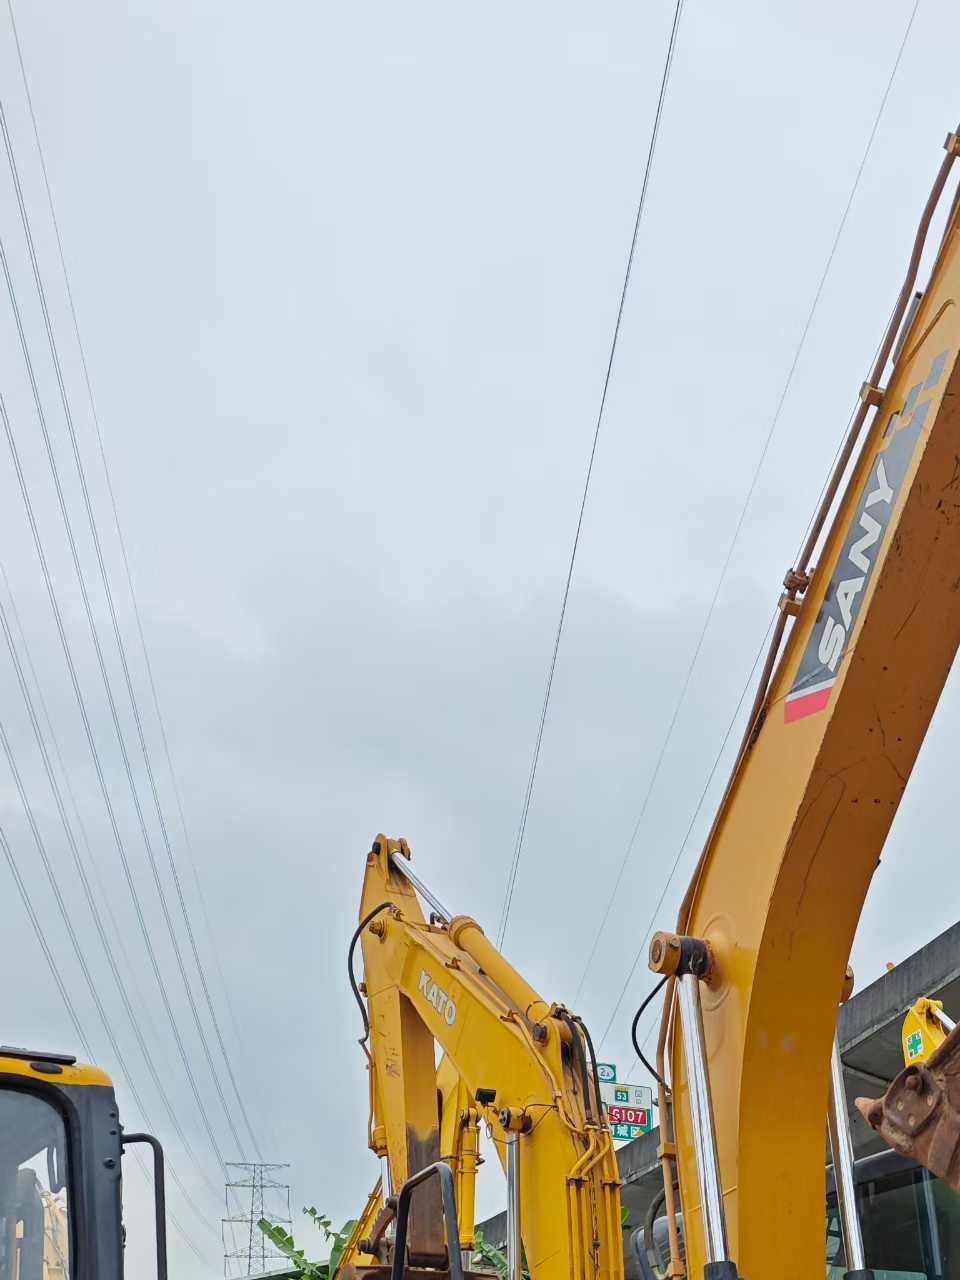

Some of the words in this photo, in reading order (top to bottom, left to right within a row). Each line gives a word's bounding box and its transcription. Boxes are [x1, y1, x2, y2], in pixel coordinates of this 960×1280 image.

[818, 457, 895, 672] SANY
[417, 968, 457, 1026] KATO
[612, 1108, 644, 1123] G107
